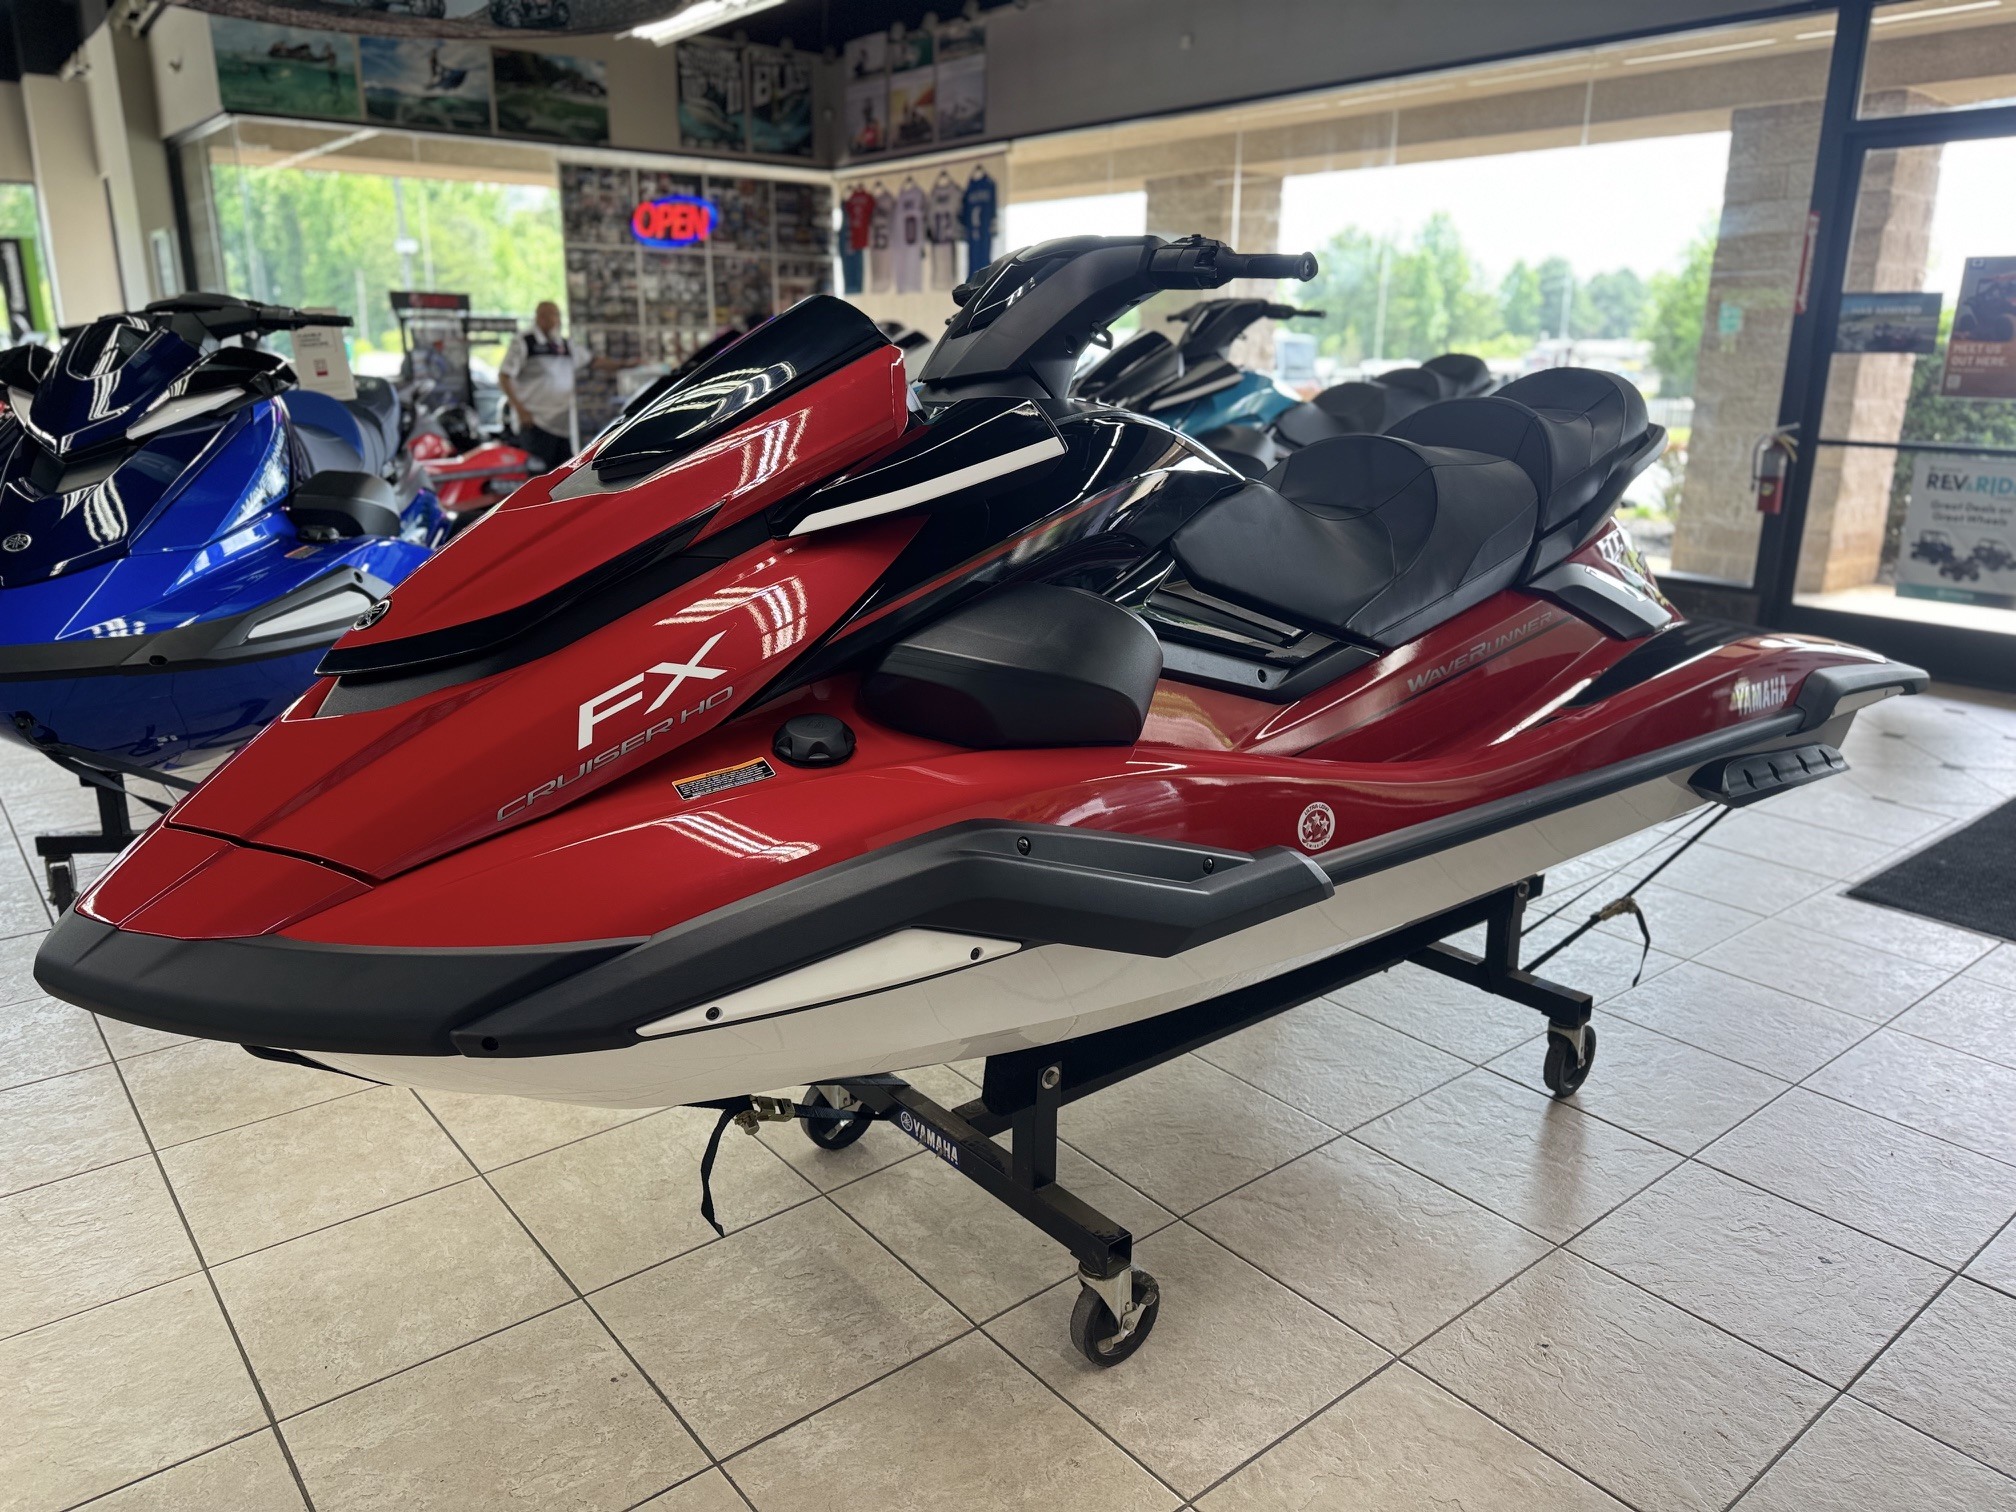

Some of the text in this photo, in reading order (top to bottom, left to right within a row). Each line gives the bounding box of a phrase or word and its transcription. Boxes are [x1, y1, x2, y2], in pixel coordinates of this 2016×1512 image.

[632, 202, 710, 240] OPEN
[1951, 356, 1973, 367] OUT
[1985, 344, 2002, 354] US
[578, 630, 728, 751] FX
[1735, 674, 1787, 717] YAMAHA
[497, 716, 674, 822] CRUISER
[681, 686, 734, 724] HO
[913, 1118, 959, 1166] YAMAHA
